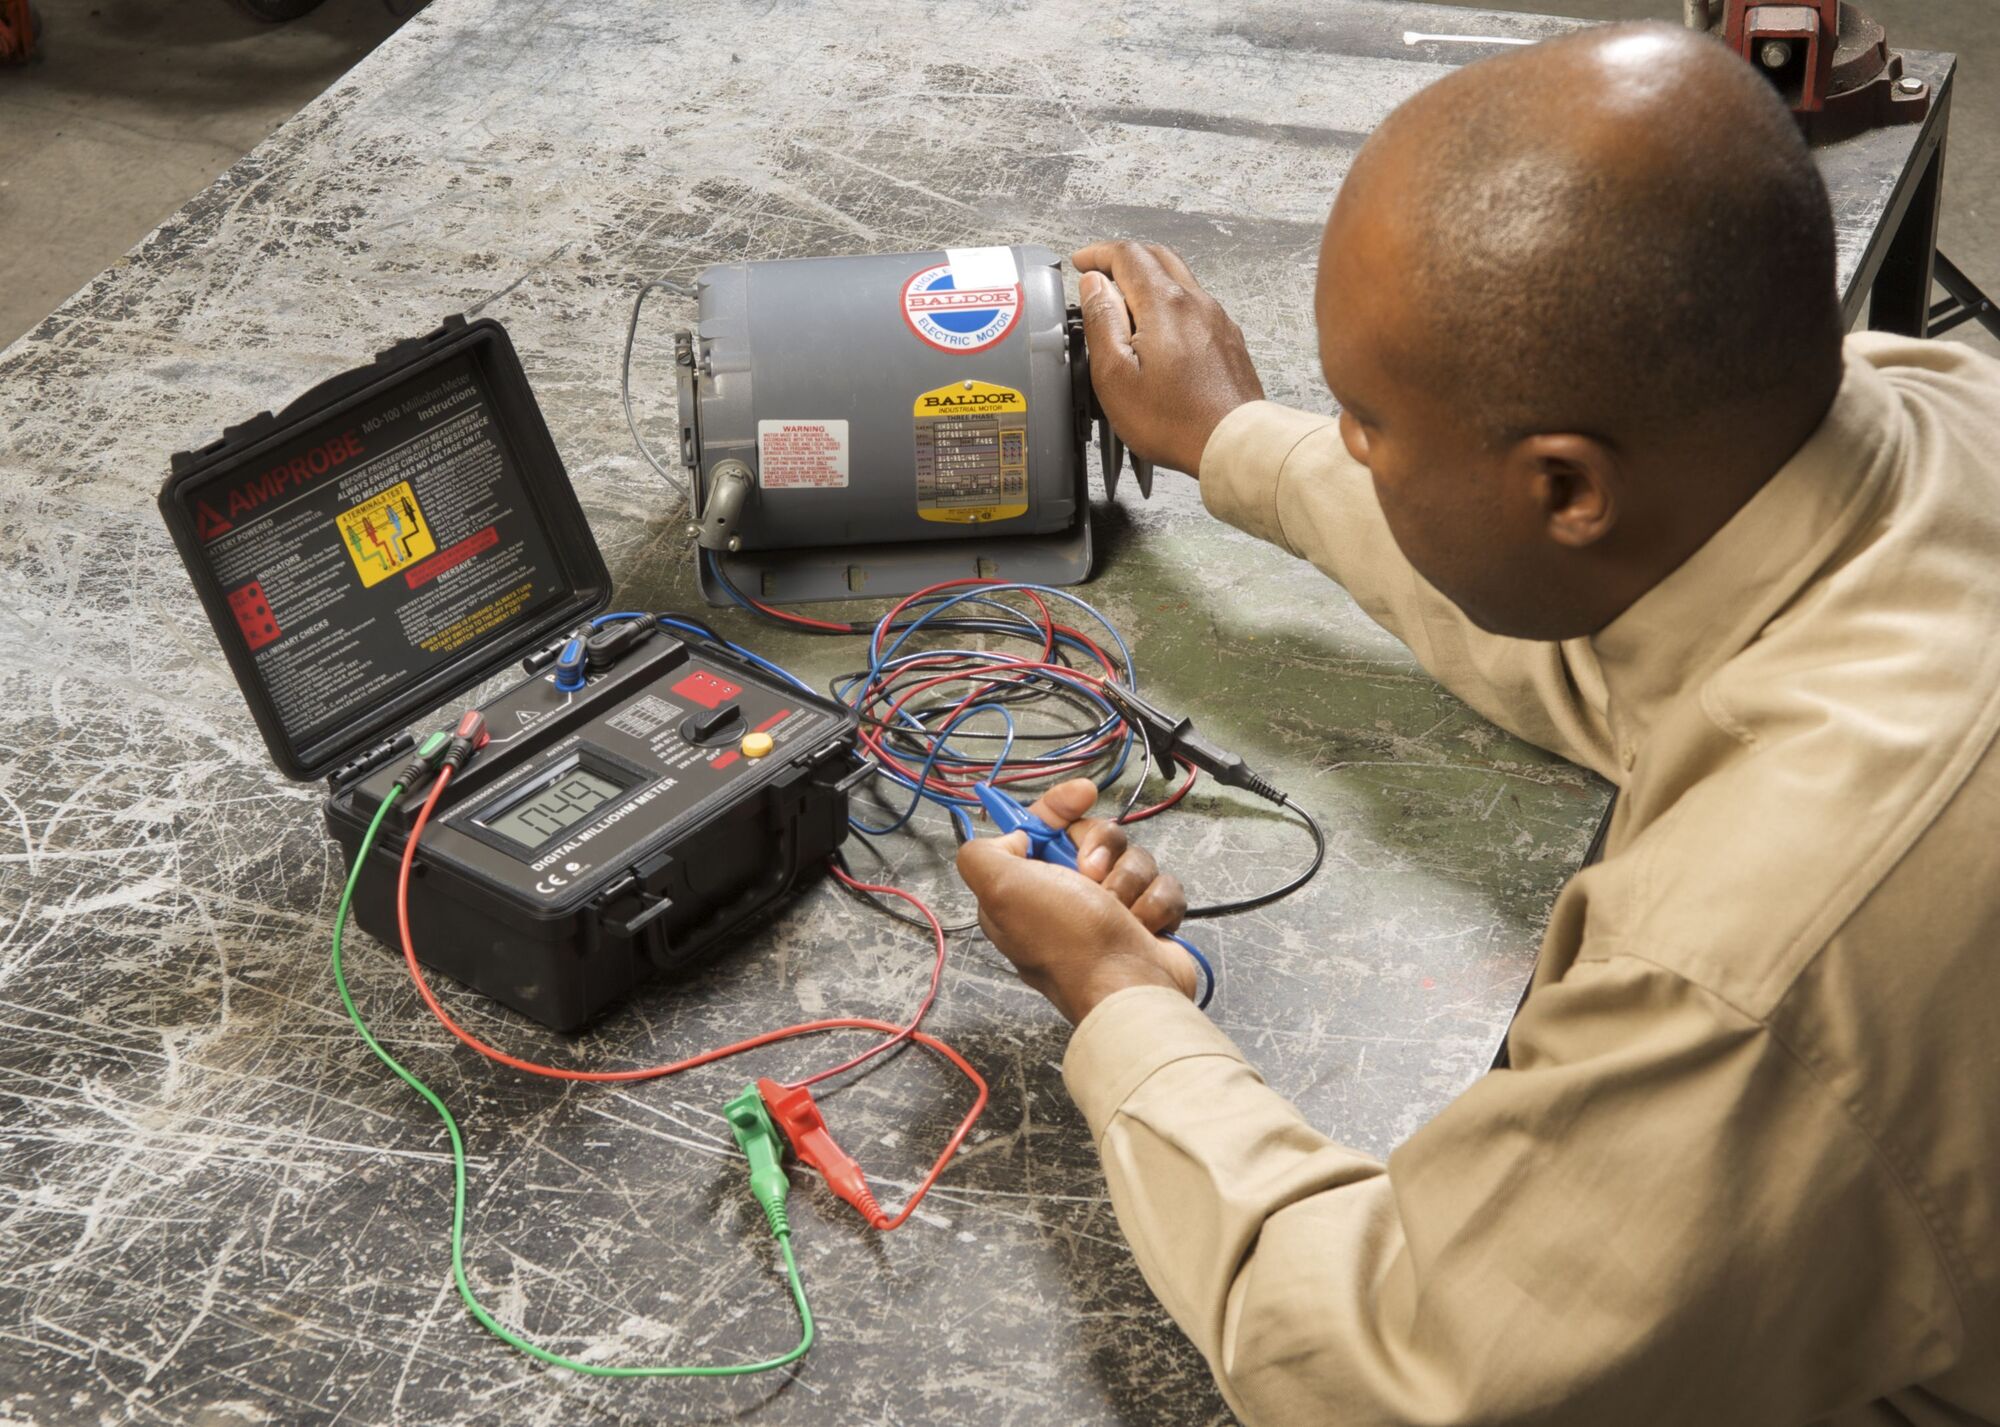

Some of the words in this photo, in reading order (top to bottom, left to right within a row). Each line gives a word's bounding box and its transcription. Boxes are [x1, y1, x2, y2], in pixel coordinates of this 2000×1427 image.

[913, 271, 938, 291] HIGH
[909, 293, 1012, 307] BALDOR
[918, 317, 971, 346] ELECTRIC
[976, 312, 1010, 343] MOTOR
[418, 385, 477, 421] Instructions
[924, 394, 1016, 407] BALDOR
[939, 405, 976, 414] INDUSTRIAL
[979, 404, 1002, 412] MOTOR
[362, 408, 400, 433] MO-100
[336, 478, 368, 500] ALWAYS
[368, 462, 401, 484] ENSURE
[400, 446, 430, 467] CIRCUIT
[430, 440, 443, 451] OR
[443, 416, 490, 445] RESISTANCE
[339, 469, 367, 488] BEFORE
[368, 446, 412, 474] PROCEEDING
[413, 437, 429, 450] WITH
[429, 411, 480, 442] MEASUREMENT
[223, 429, 365, 516] AMPROBE
[350, 493, 362, 504] TO
[362, 474, 399, 498] MEASURE
[400, 465, 416, 479] HAS
[416, 459, 428, 470] NO
[428, 441, 463, 464] VOLTAGE
[463, 436, 474, 446] ON
[348, 495, 386, 519] TERMINALS
[387, 486, 403, 499] TEST
[208, 536, 237, 557] ATTERY
[237, 518, 274, 542] POWERED
[257, 553, 300, 581] INDICATORS
[430, 635, 452, 651] ROTARY
[452, 623, 474, 639] SWITCH
[474, 618, 482, 626] TO
[483, 612, 493, 621] THE
[493, 606, 504, 616] OFF
[505, 591, 531, 609] POSITION
[444, 643, 452, 651] TO
[452, 630, 474, 647] SWITCH
[476, 610, 510, 633] INSTRUMENT
[511, 604, 521, 614] OFF
[255, 634, 299, 663] RELIMINARY
[299, 618, 329, 639] CHECKS
[530, 839, 582, 872] DIGITAL
[578, 802, 638, 842] MILLIOHM
[634, 777, 678, 807] METER
